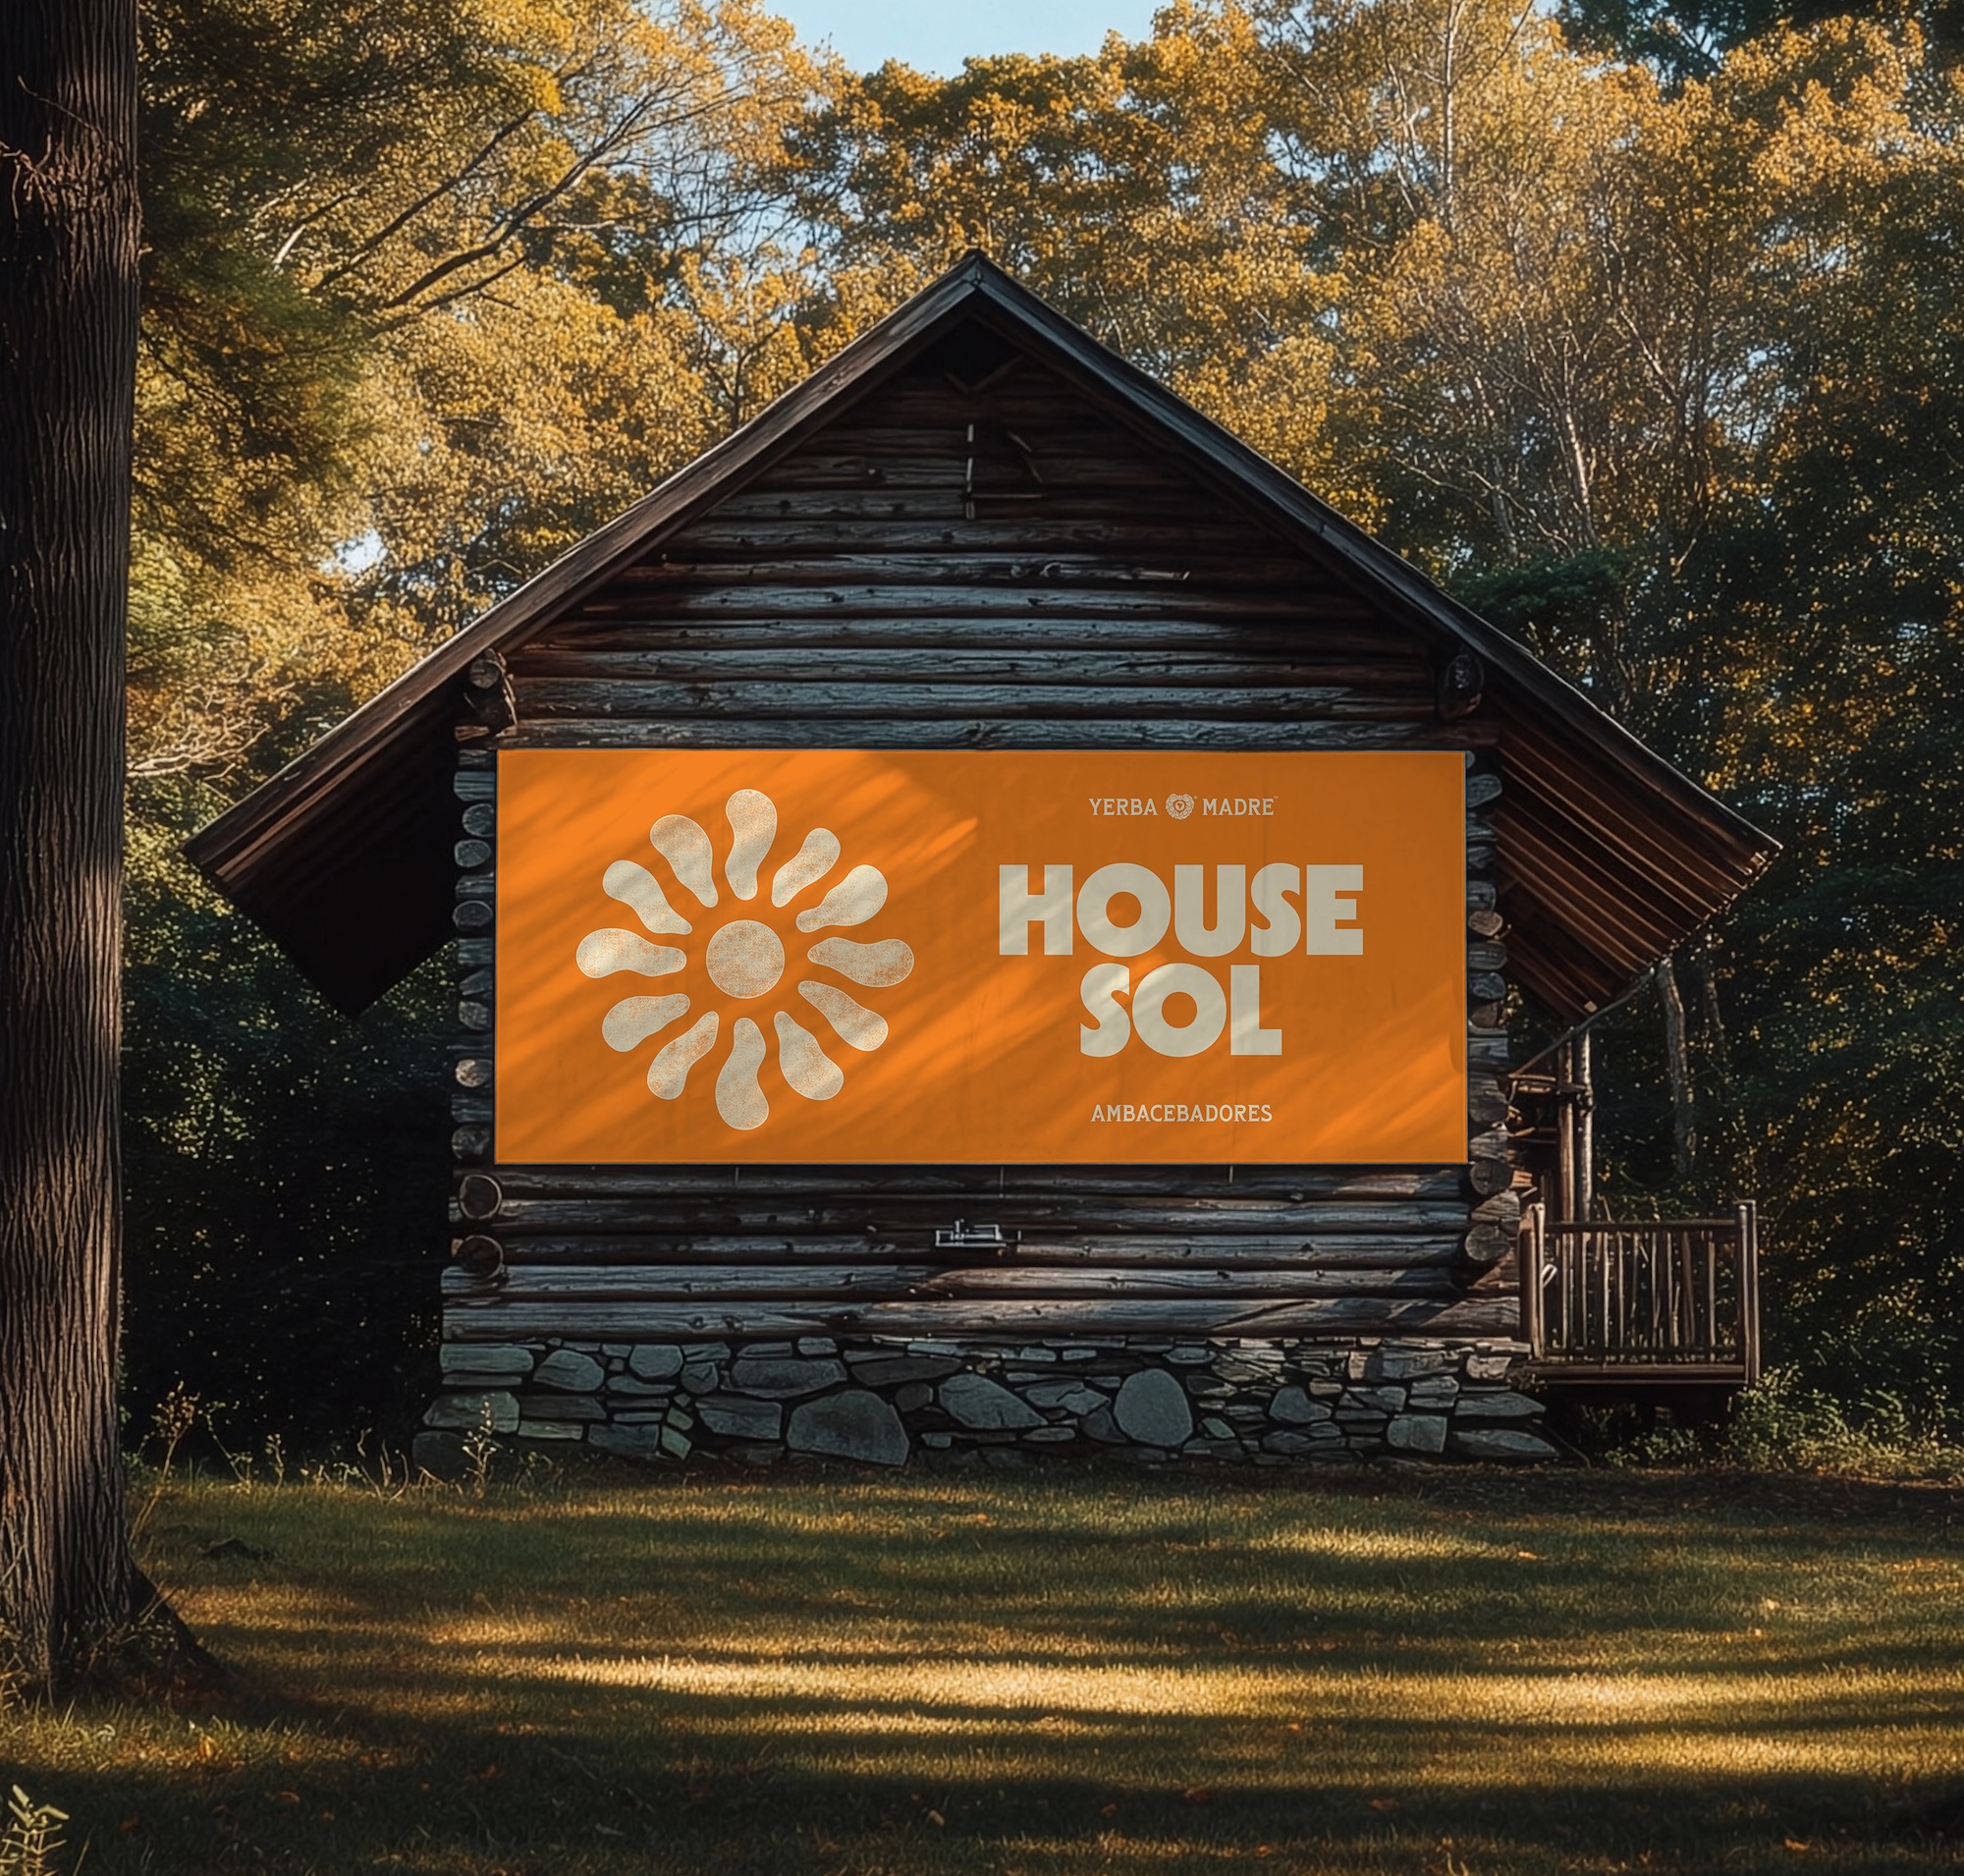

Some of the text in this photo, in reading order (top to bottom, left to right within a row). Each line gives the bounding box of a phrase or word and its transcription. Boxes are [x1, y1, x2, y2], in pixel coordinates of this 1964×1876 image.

[1089, 798, 1158, 815] YERBA
[999, 862, 1364, 957] HOUSE
[1080, 963, 1282, 1058] SOL
[1090, 1104, 1273, 1122] AMBACEBADORES
